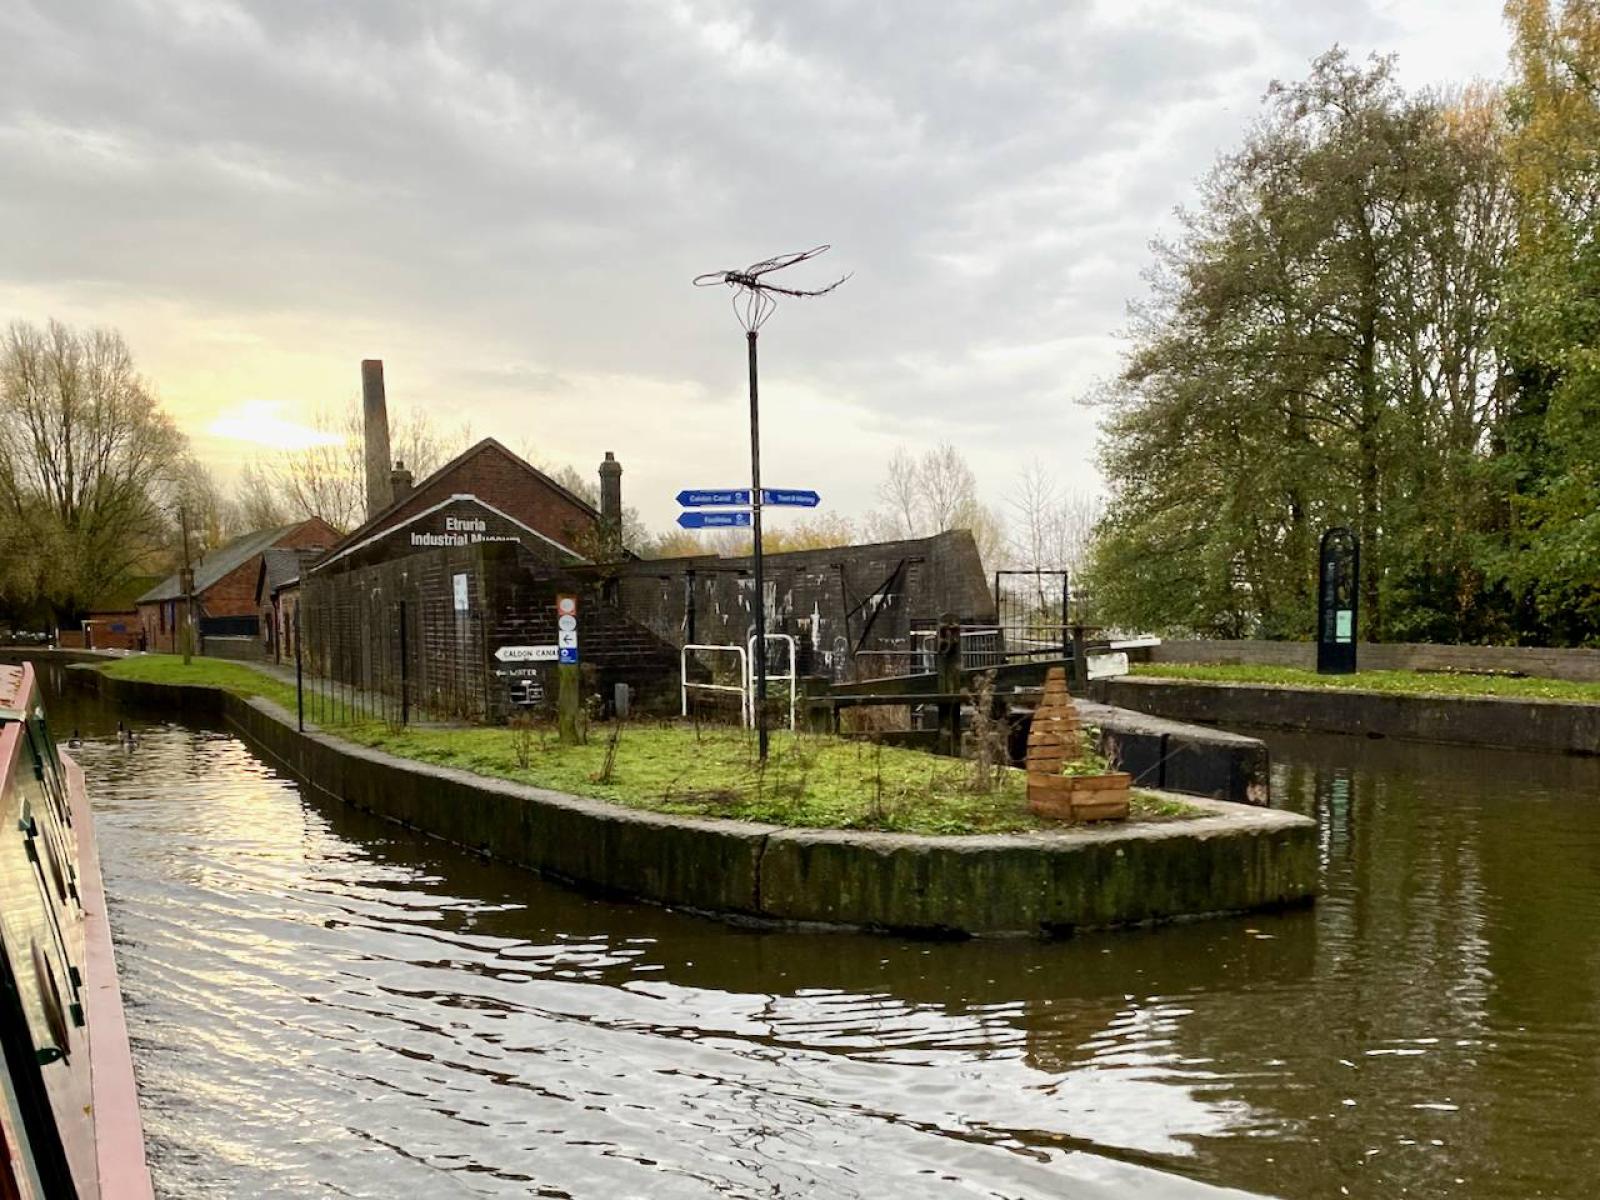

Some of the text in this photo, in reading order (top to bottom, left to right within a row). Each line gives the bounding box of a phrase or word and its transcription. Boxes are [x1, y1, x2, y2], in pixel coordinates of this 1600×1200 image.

[445, 516, 486, 531] Etruria
[410, 532, 468, 546] Industrial
[503, 649, 533, 657] CALDON
